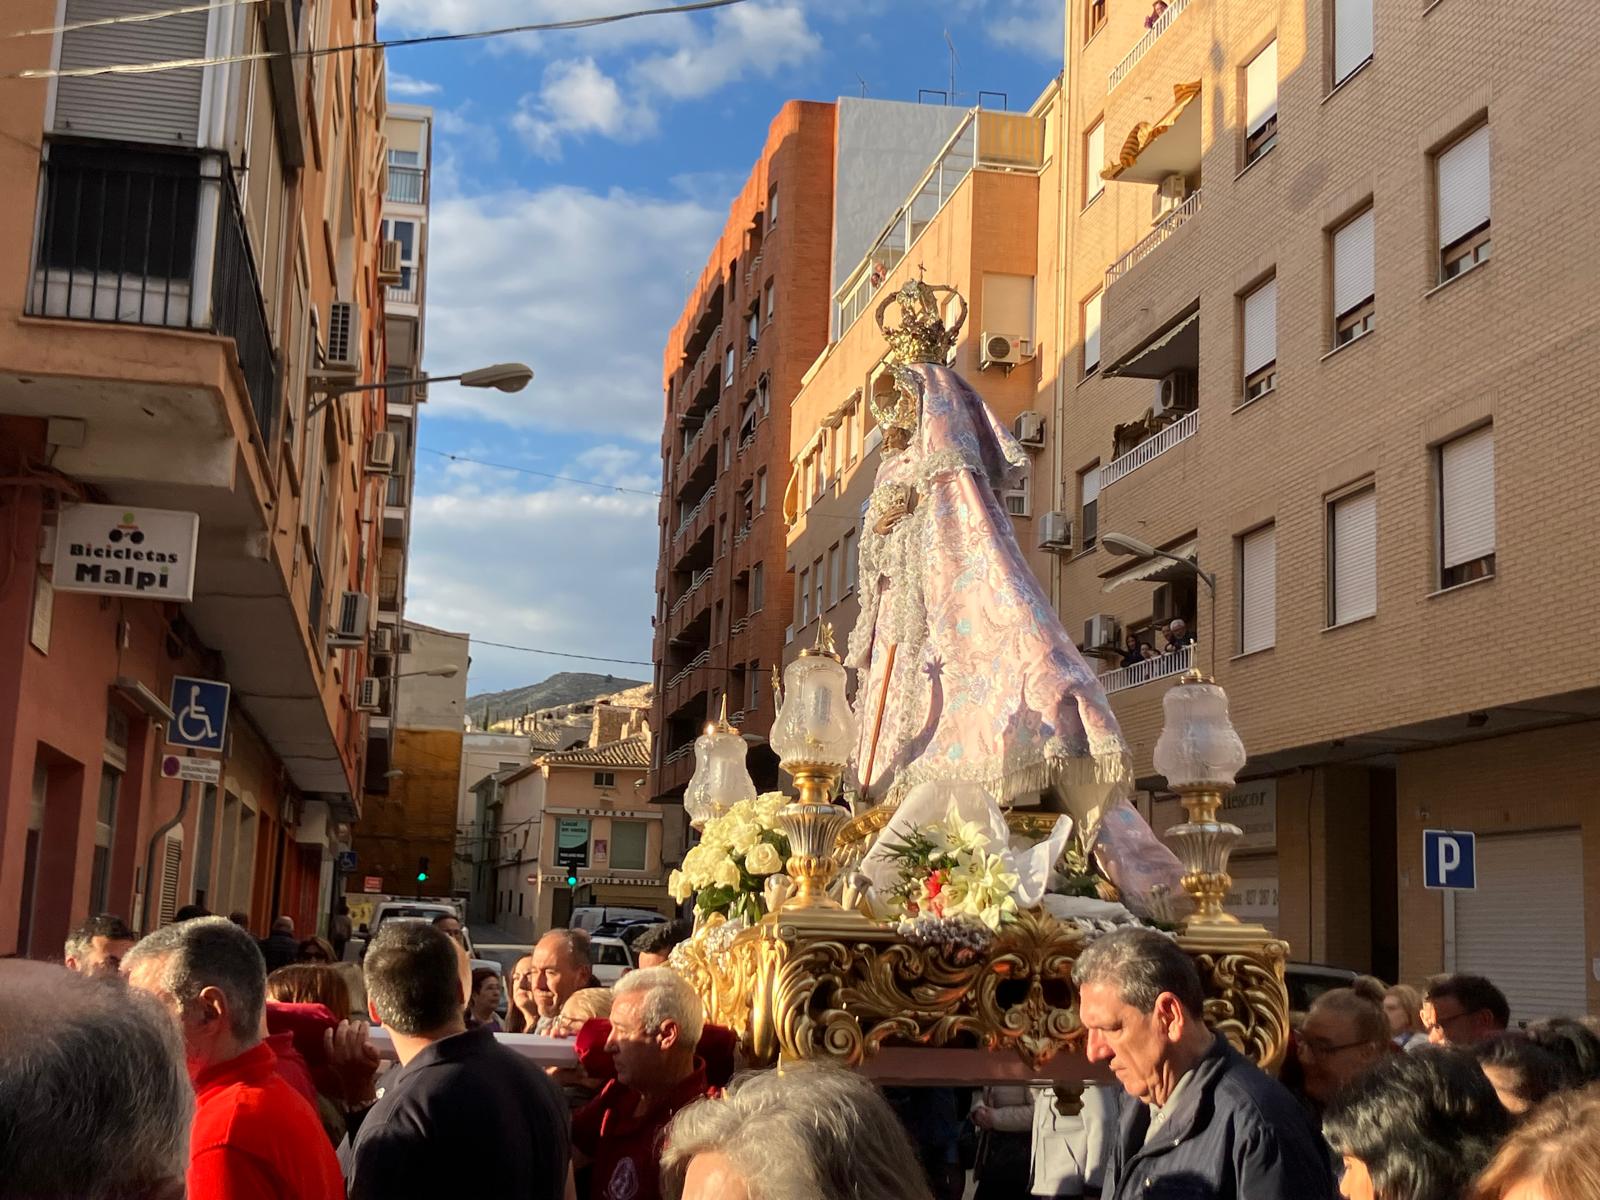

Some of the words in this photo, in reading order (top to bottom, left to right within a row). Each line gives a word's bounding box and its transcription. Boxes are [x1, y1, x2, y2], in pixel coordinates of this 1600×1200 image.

[70, 543, 178, 563] Bicicletas
[75, 563, 169, 590] Malpi
[576, 808, 634, 817] TROFEOS
[1438, 837, 1460, 884] P
